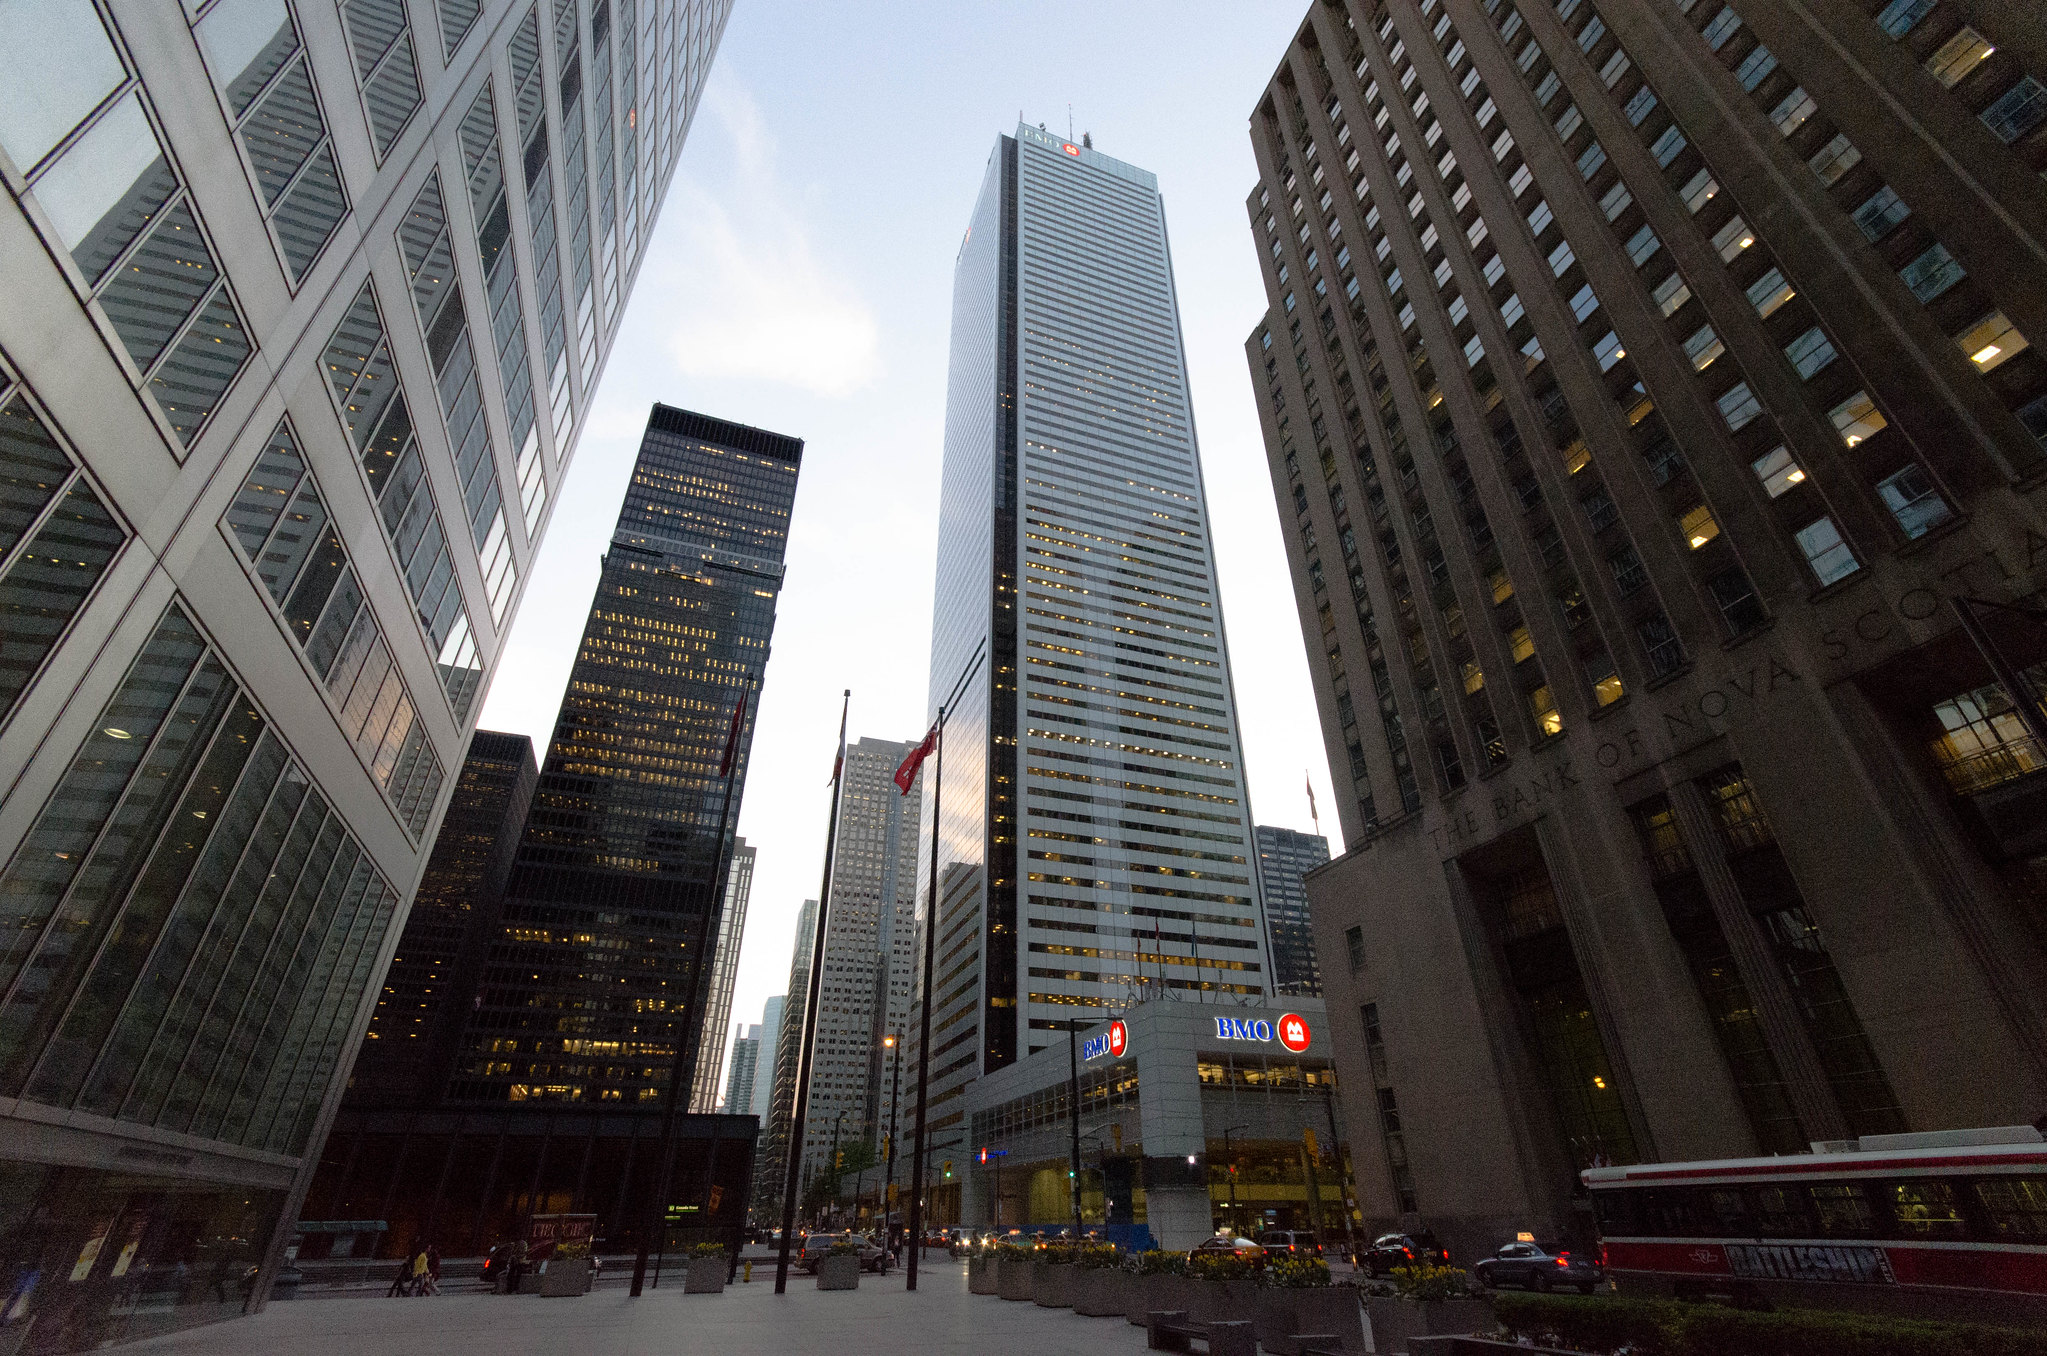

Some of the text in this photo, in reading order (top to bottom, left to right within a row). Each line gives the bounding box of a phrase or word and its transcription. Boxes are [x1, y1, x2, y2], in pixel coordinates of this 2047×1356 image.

[1427, 529, 2047, 850] THE BANK OF NOVA SCOTIA
[1214, 1017, 1275, 1042] BMO
[1083, 1032, 1111, 1062] BMO
[1727, 1245, 1879, 1283] BATTLESHIP
